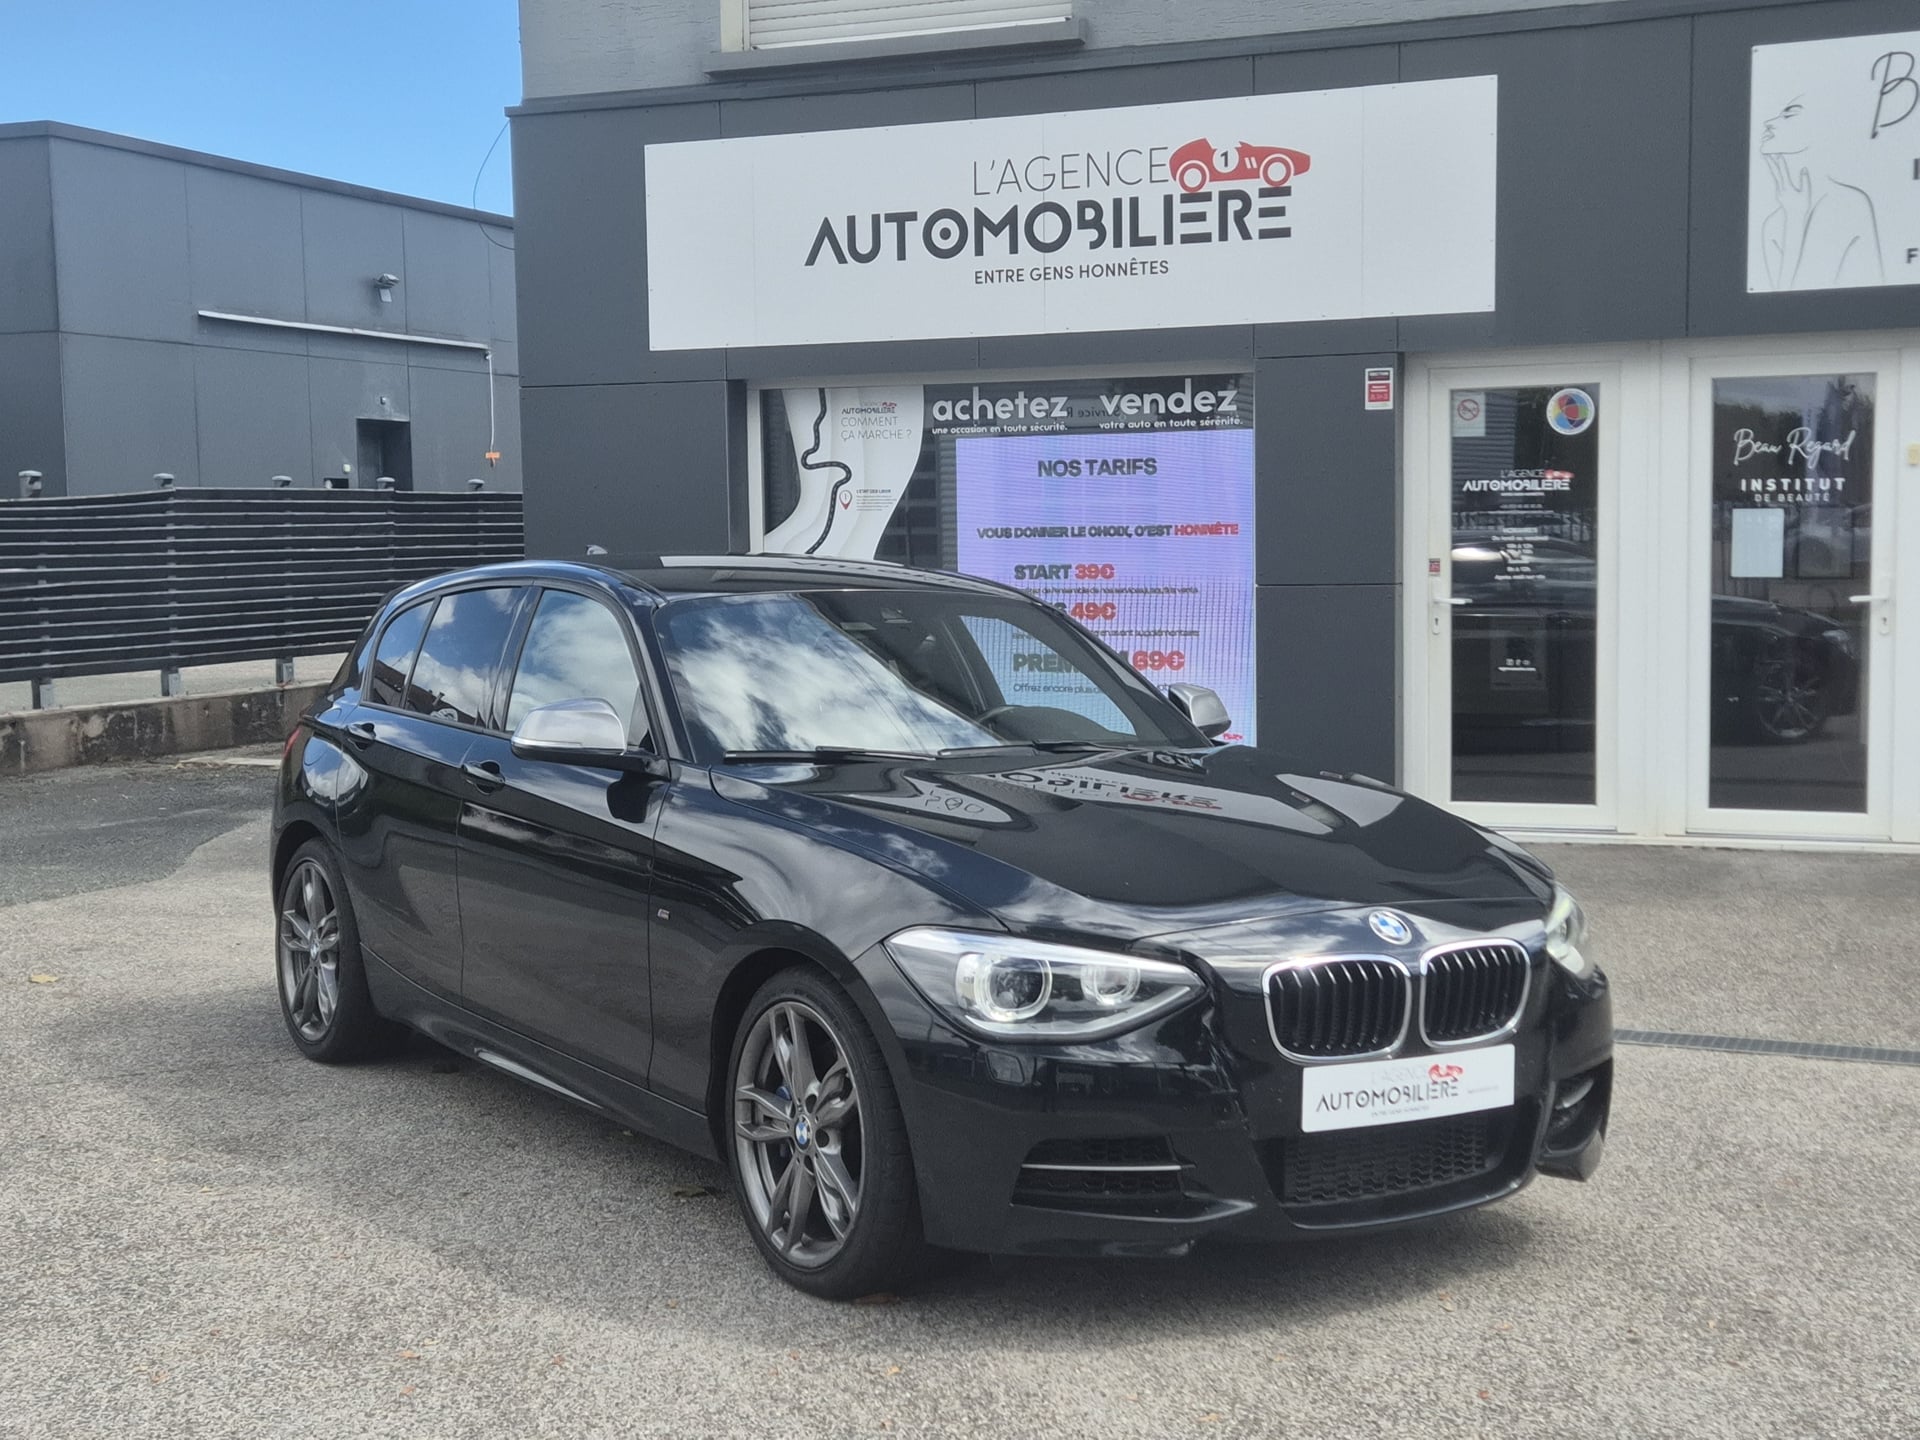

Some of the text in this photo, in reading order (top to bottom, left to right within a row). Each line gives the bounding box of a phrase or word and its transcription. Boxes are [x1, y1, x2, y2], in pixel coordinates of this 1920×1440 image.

[974, 147, 1169, 195] L'AGENCE
[804, 186, 1292, 266] AUTOMOBILIERE
[975, 257, 1169, 284] ENTRE GENS HONNÊTES
[932, 386, 1068, 421] achetez
[1100, 378, 1238, 415] vendez
[841, 416, 898, 427] COMMENT
[932, 426, 948, 435] une
[950, 423, 987, 434] occasion
[990, 426, 1001, 434] en
[1003, 423, 1027, 433] toute
[1099, 420, 1125, 430] votre
[1128, 420, 1151, 429] auto
[1169, 418, 1197, 427] toute
[858, 429, 903, 440] MARCHE
[1733, 426, 1856, 469] Beau Regard
[1037, 457, 1158, 478] NOS TARIFS
[1740, 477, 1846, 492] INSTITUT
[1754, 493, 1771, 502] DE
[976, 527, 1013, 539] VOUS
[1014, 526, 1069, 538] DONNER
[1070, 525, 1086, 537] LE
[1014, 563, 1073, 580] START
[1069, 602, 1117, 620] 49€
[1131, 650, 1185, 672] 69€
[1013, 683, 1041, 692] Offrez
